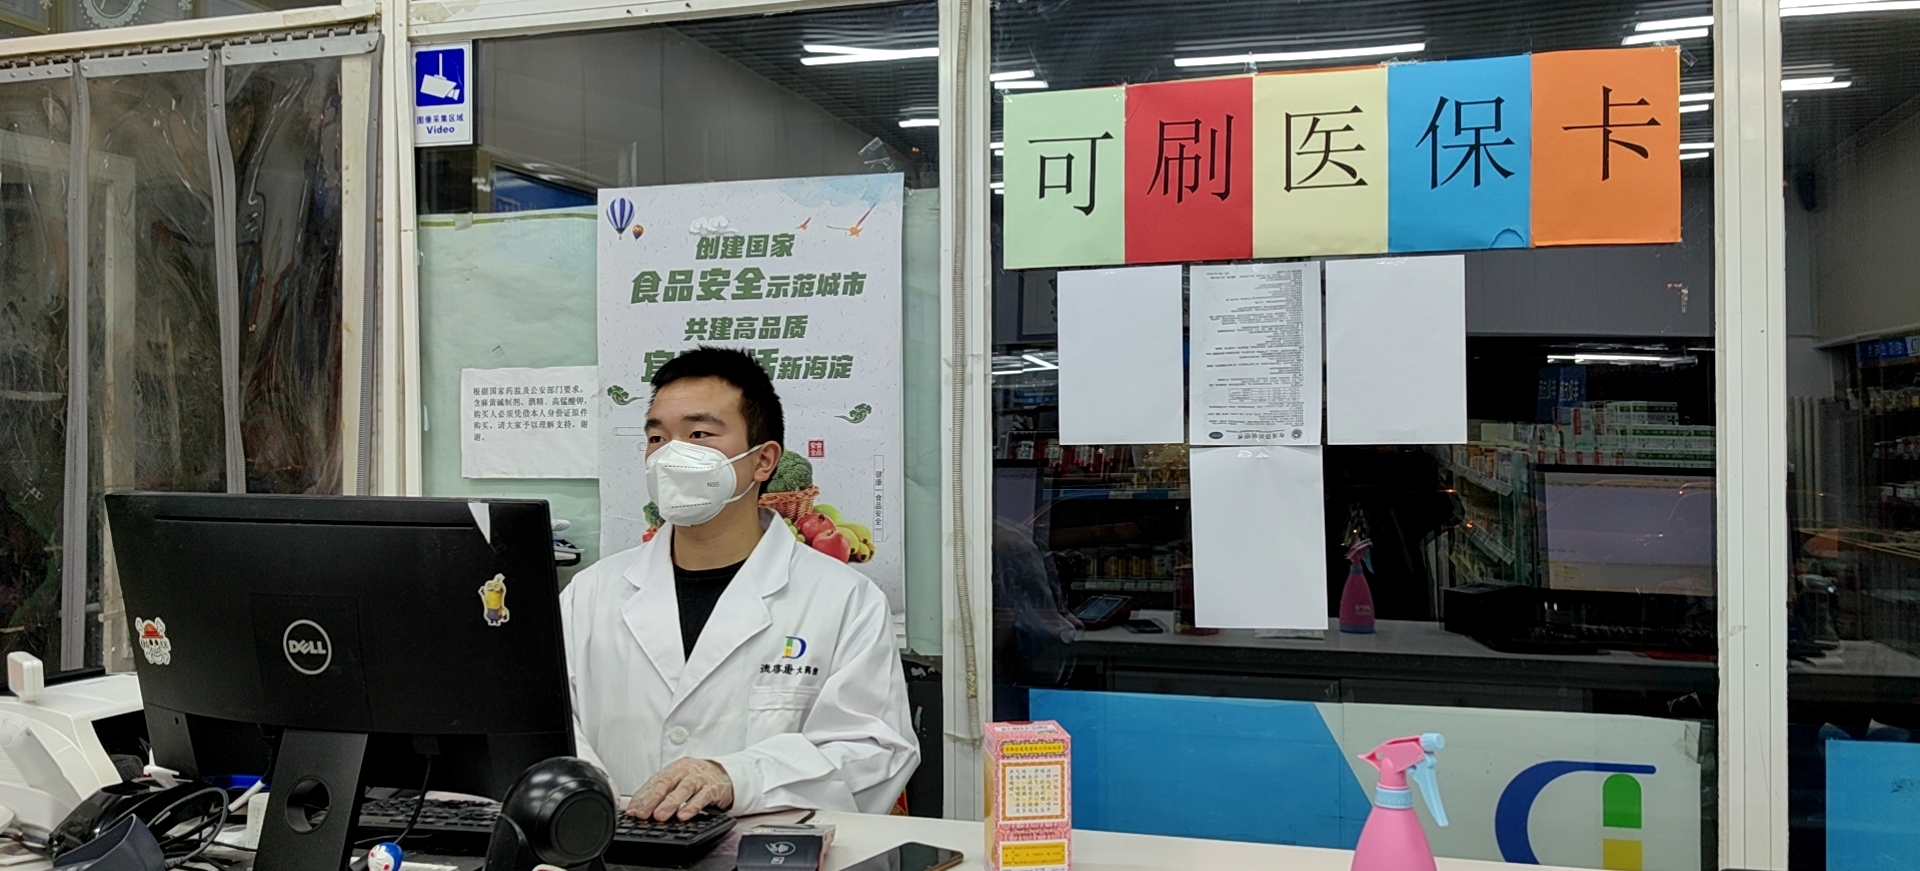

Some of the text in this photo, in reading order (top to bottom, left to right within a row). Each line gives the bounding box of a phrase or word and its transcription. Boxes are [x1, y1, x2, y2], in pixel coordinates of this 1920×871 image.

[416, 113, 464, 125] 图像采集区域
[426, 125, 455, 135] Video
[1028, 85, 1662, 217] 可刷医保卡
[695, 232, 796, 261] 创建国家
[630, 267, 867, 304] 食品安全示范城市
[683, 314, 808, 341] 共建高品质
[288, 639, 327, 655] DELL
